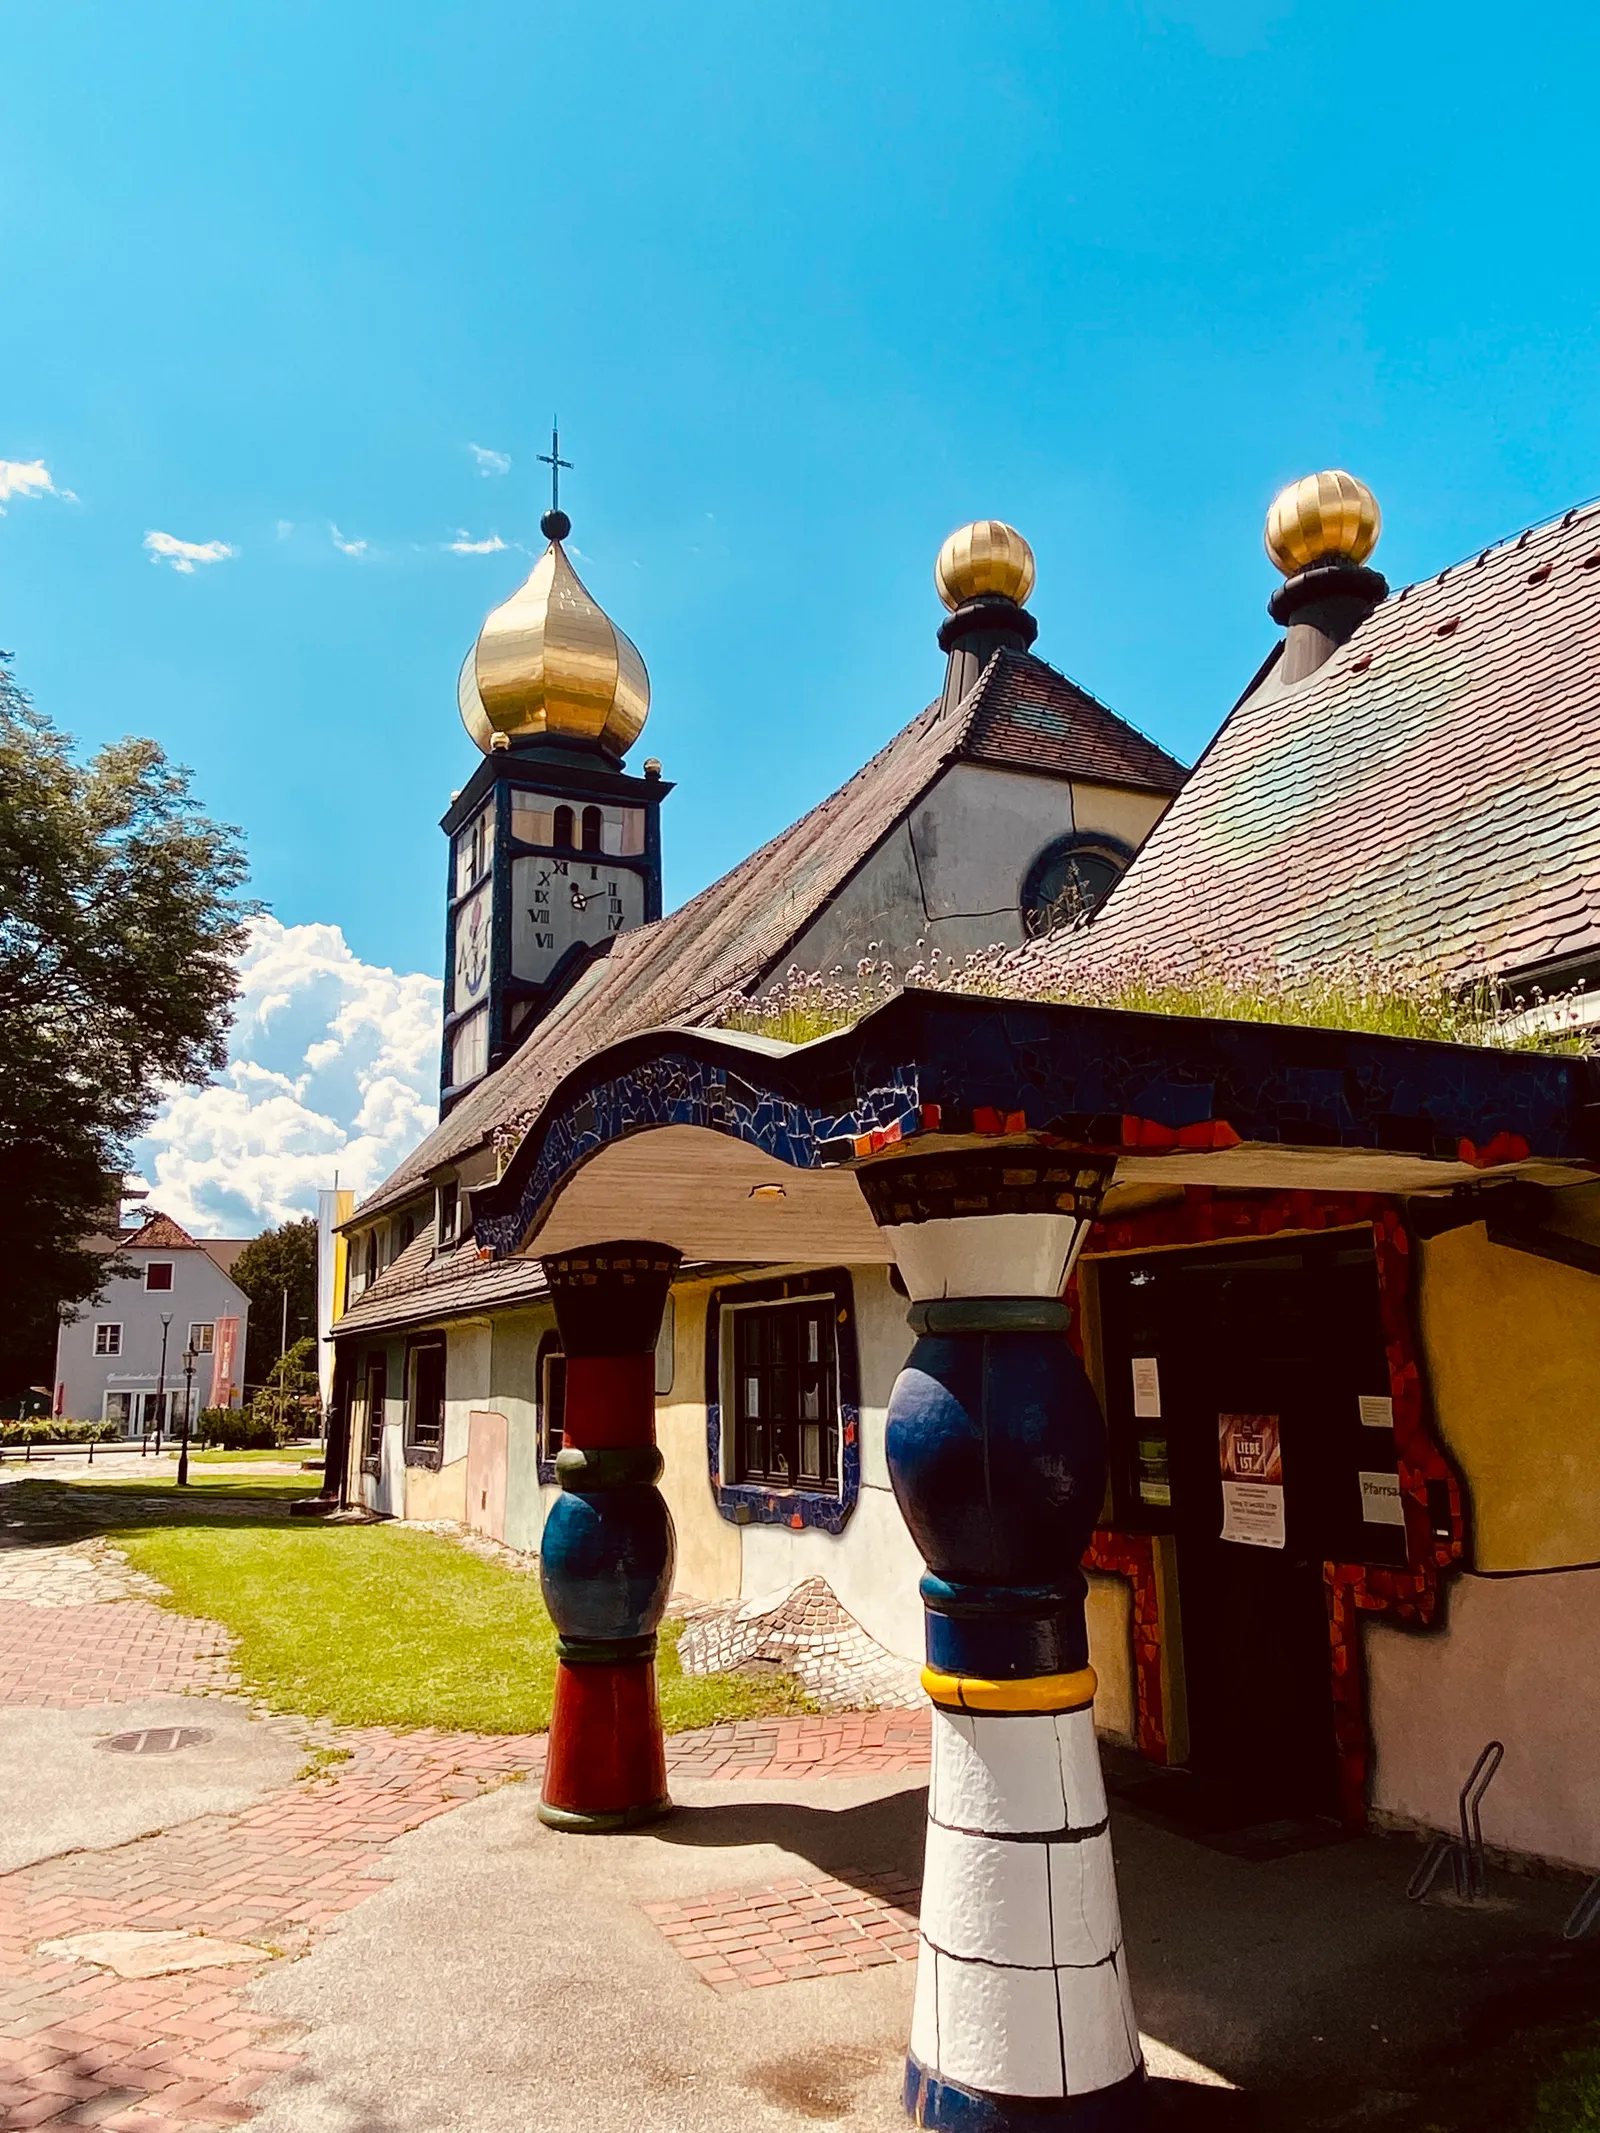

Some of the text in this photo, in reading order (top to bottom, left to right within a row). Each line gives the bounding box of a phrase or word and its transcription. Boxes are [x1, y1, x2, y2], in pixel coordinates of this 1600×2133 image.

[552, 860, 569, 876] XI
[537, 871, 551, 886] X
[608, 882, 617, 896] II
[535, 890, 549, 904] IX
[610, 898, 623, 914] III
[527, 909, 550, 924] VIII
[608, 915, 625, 930] IV
[535, 933, 554, 949] VII
[1236, 1441, 1261, 1455] LIEBE
